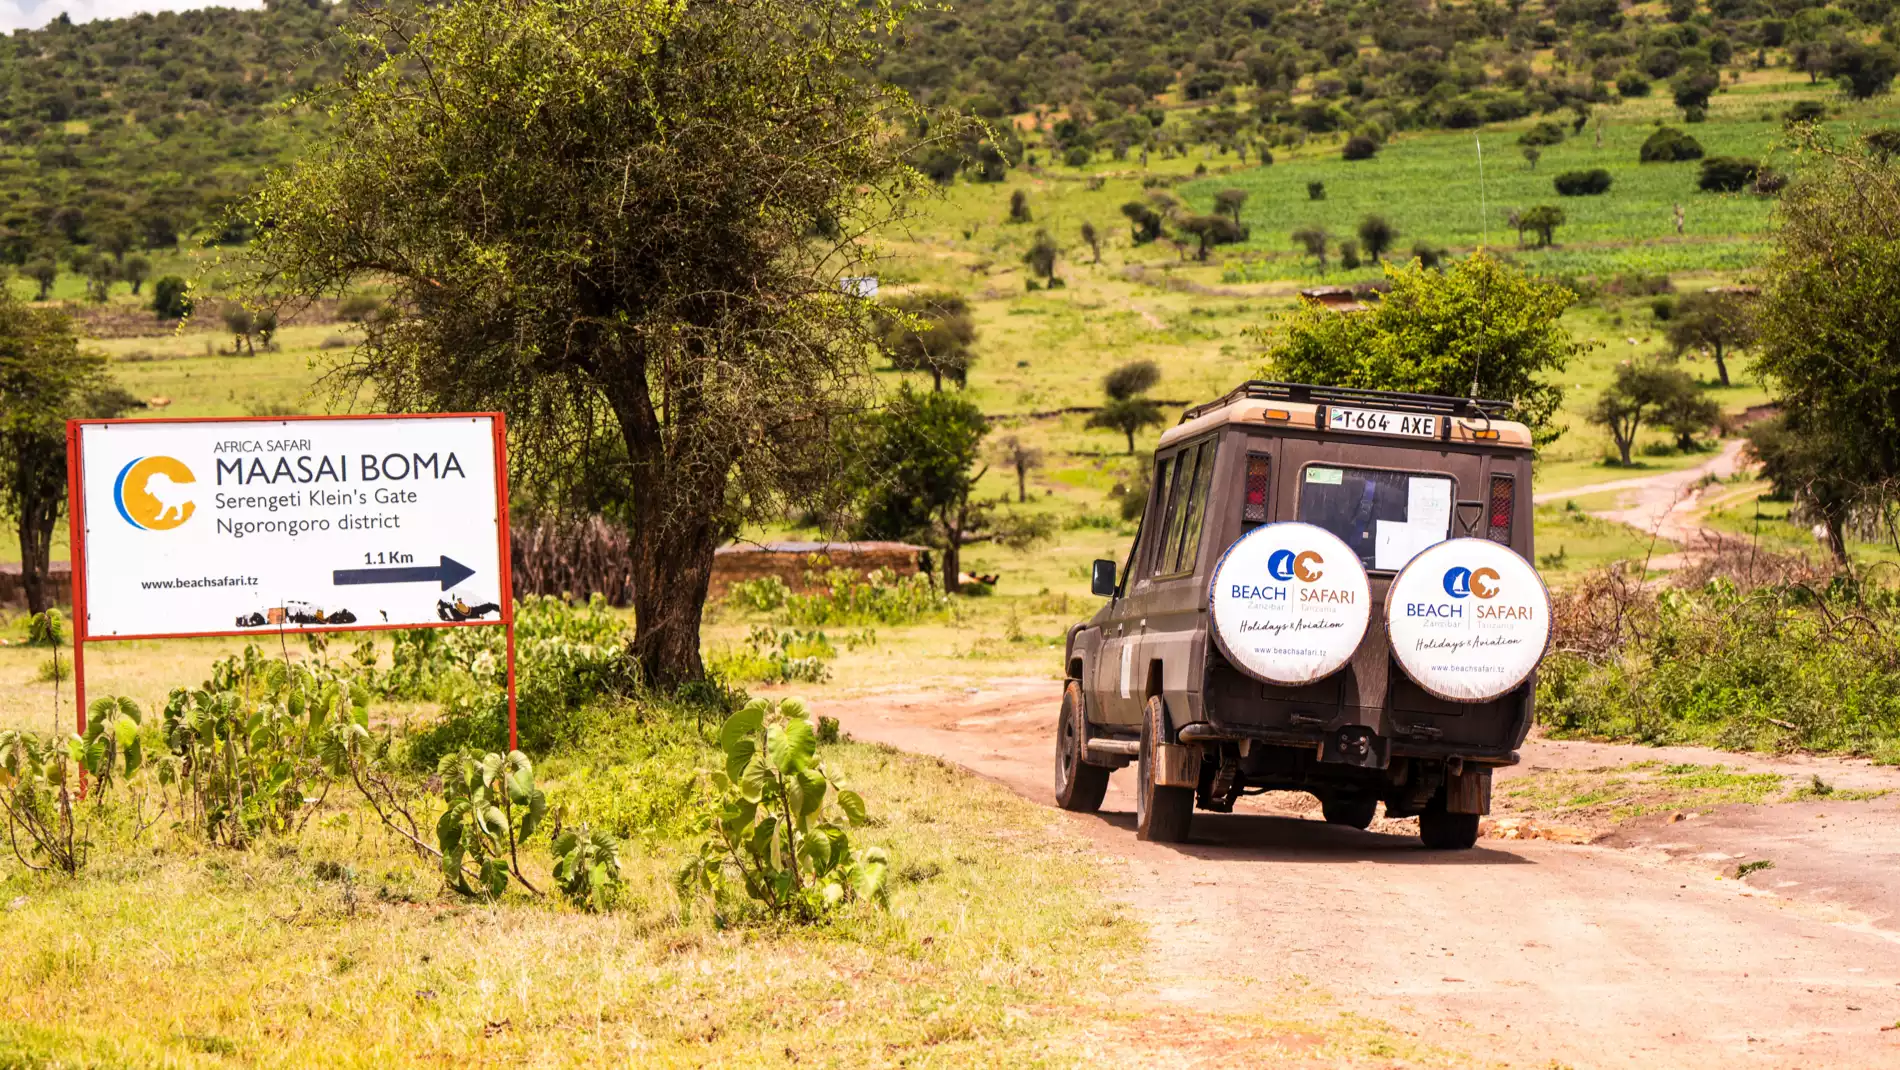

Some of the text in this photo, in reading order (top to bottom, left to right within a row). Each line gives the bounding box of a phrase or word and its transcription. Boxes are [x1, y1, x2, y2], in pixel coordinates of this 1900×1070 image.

[1400, 416, 1433, 435] AXE
[213, 439, 311, 453] AFRICA SAFARI
[216, 452, 466, 485] MAASAI BOMA
[215, 488, 417, 512] Serengeti Klein's Gate
[217, 512, 400, 538] Ngorongoro district
[364, 551, 414, 565] 1.1 Km
[141, 576, 259, 589] www.beachsafari.tz
[1231, 584, 1355, 604] BEACH SAFARI
[1407, 603, 1533, 620] BEACH SAFARI
[1239, 619, 1288, 636] Holidays
[1295, 618, 1344, 632] Aviation
[1254, 646, 1327, 657] www.beachsafari.tz
[1415, 637, 1465, 654] Holidays
[1472, 634, 1522, 649] Aviation
[1430, 663, 1505, 673] www.beachsafari.tz
